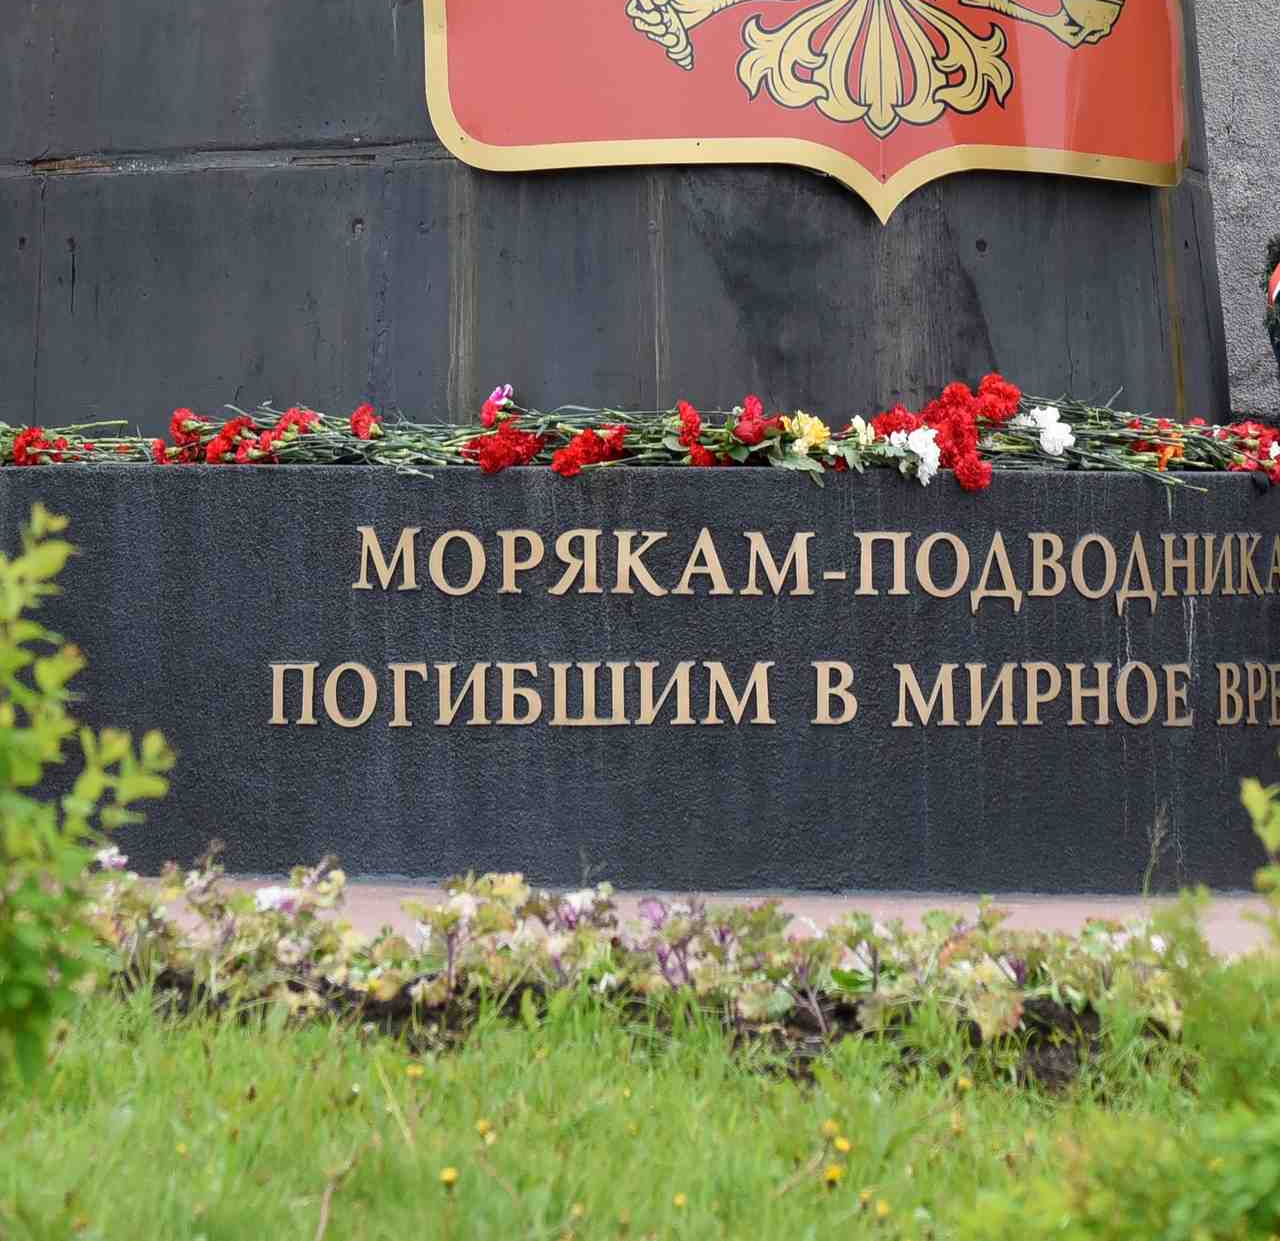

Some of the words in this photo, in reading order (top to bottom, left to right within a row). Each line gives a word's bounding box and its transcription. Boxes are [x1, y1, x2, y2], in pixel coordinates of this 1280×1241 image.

[268, 661, 777, 727] ПОГИБШИМ
[813, 661, 859, 726] В
[893, 661, 1193, 727] МИРНОЕ
